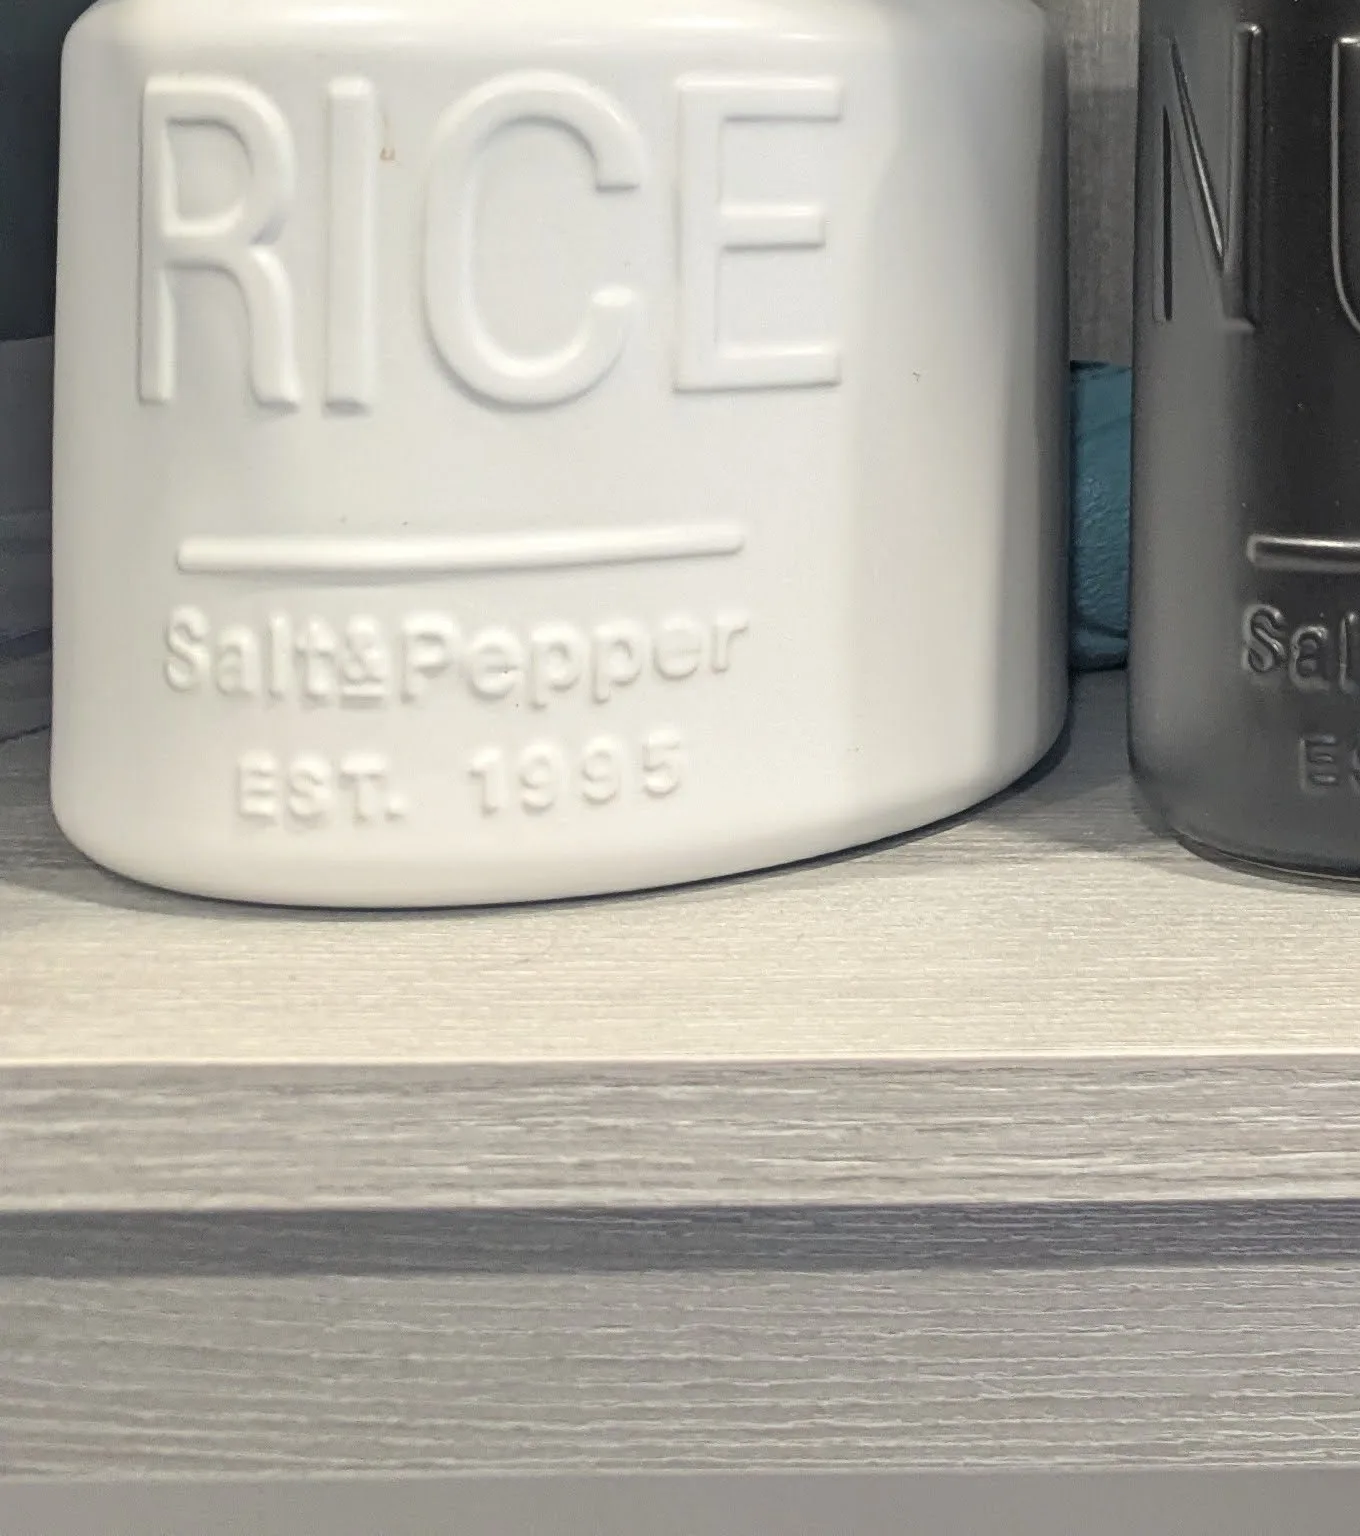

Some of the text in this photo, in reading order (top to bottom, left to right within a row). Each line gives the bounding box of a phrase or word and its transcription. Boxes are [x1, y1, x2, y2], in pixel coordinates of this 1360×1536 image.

[136, 68, 850, 416] RICE
[162, 602, 752, 712] Salt&Pepper
[232, 726, 690, 830] EST. 1995
